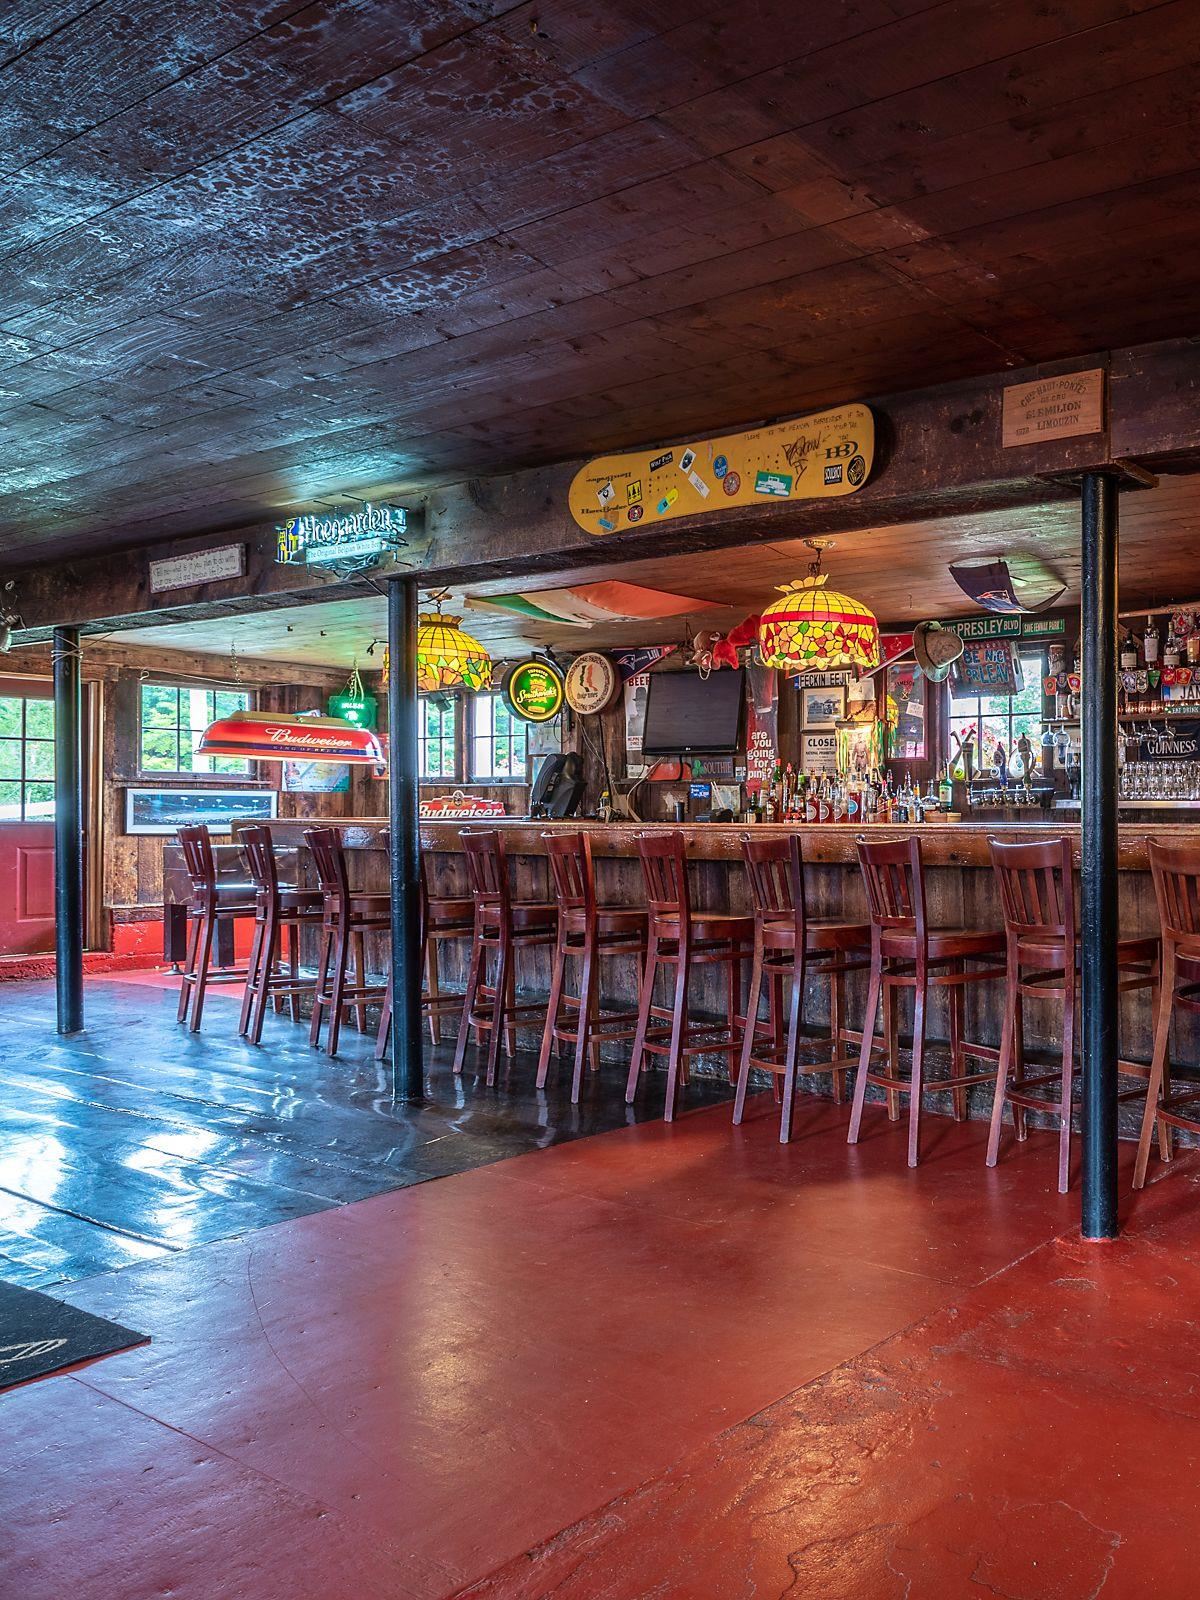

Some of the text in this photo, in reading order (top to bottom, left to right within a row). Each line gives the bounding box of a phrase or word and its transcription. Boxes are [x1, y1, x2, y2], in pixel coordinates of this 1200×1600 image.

[302, 503, 392, 545] Hoegaarden
[957, 619, 1020, 637] PRESLEY BLVD
[963, 649, 981, 665] BE
[800, 673, 825, 688] FECKIN
[1183, 705, 1200, 713] DRINK
[264, 727, 352, 747] Budweiser
[751, 731, 768, 741] are
[754, 739, 772, 751] you
[1146, 739, 1198, 756] GUINNESS
[747, 748, 776, 761] going
[703, 760, 732, 775] SOUTHIE
[754, 758, 769, 769] for
[419, 803, 503, 818] Budweiser
